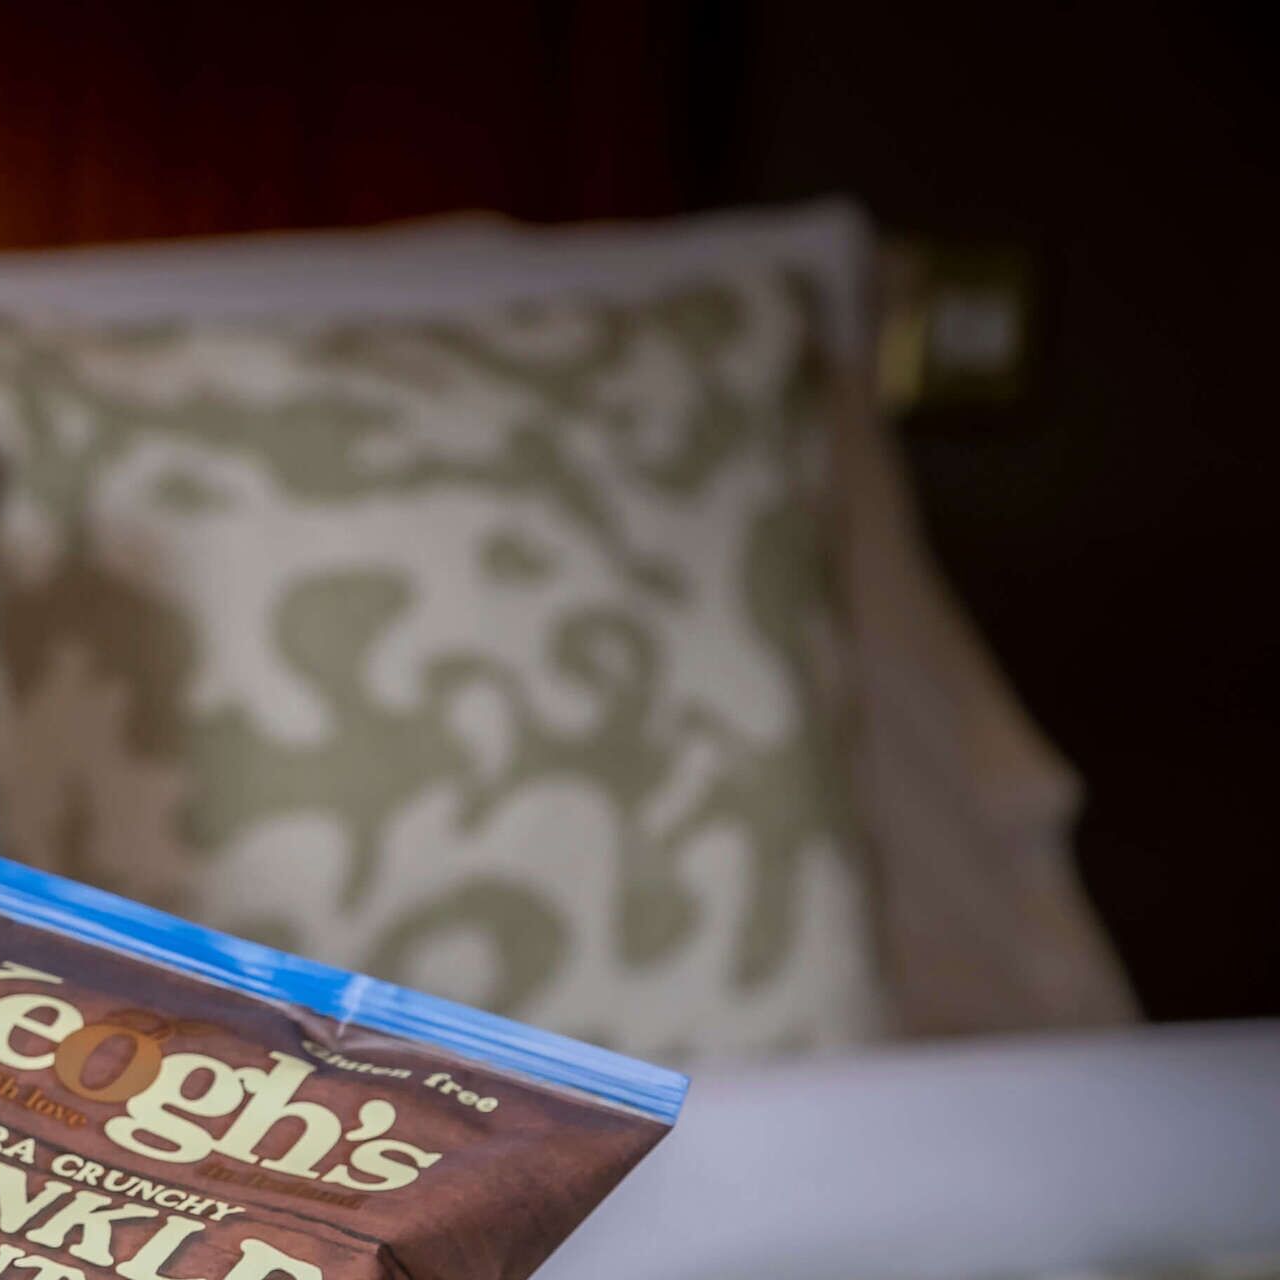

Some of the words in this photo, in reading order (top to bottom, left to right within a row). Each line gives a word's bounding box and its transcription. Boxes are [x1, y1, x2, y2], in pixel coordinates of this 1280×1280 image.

[24, 1085, 89, 1128] love
[423, 1073, 499, 1113] free
[50, 1153, 246, 1222] CRUNCHY
